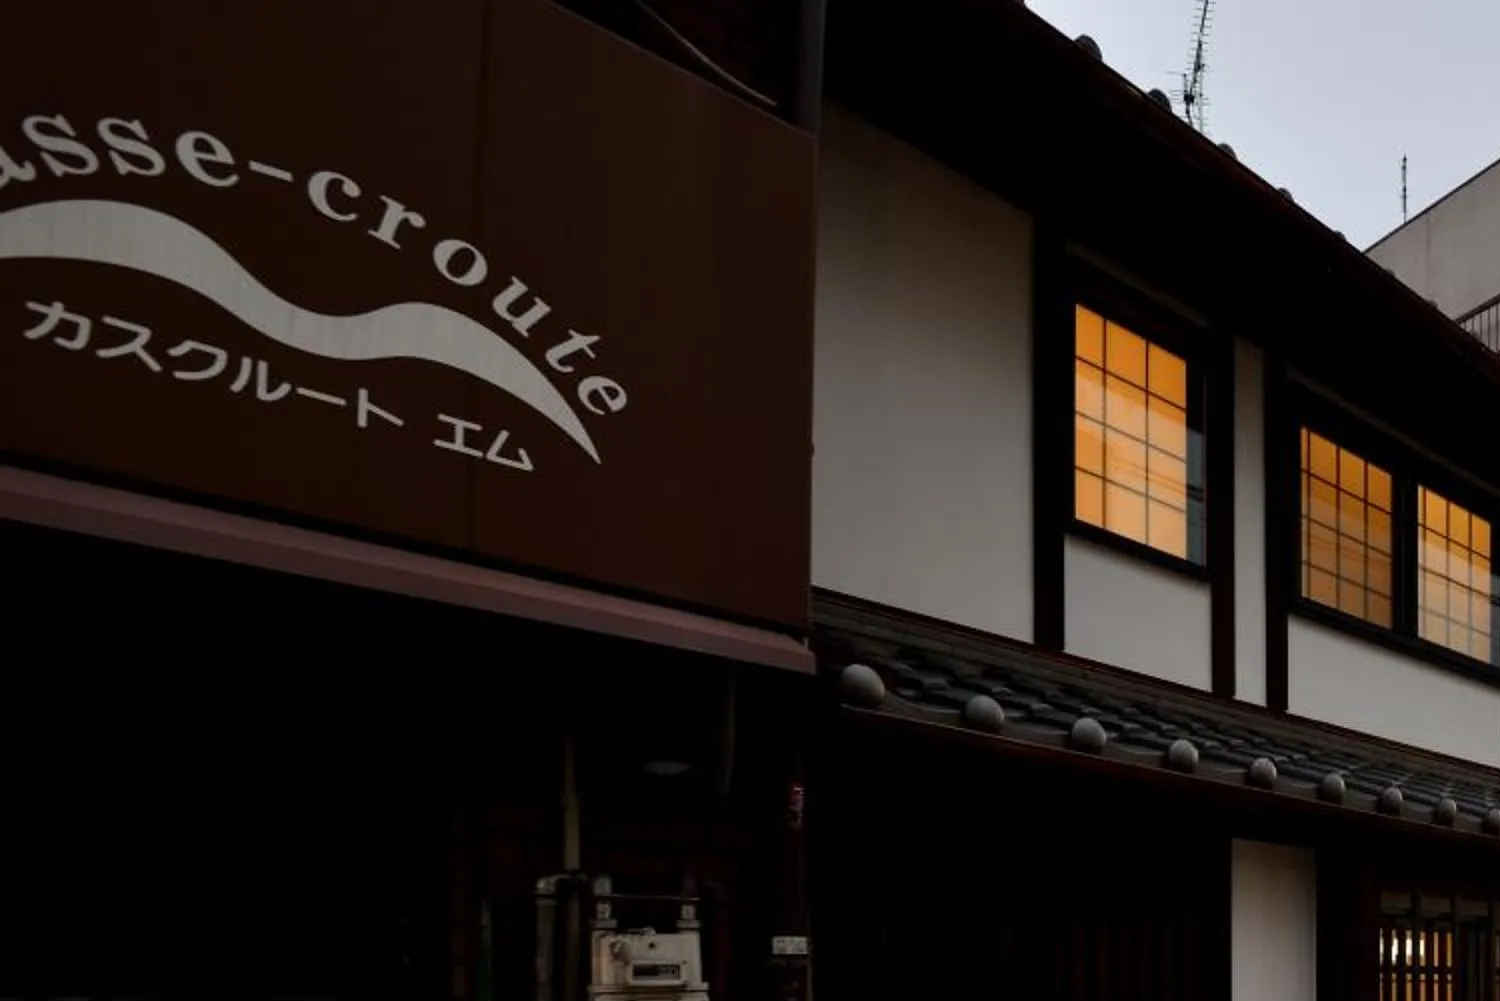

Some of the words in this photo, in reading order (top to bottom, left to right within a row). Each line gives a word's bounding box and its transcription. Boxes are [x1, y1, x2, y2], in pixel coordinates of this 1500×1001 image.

[23, 300, 405, 429] カスクルート
[433, 413, 534, 472] エム
